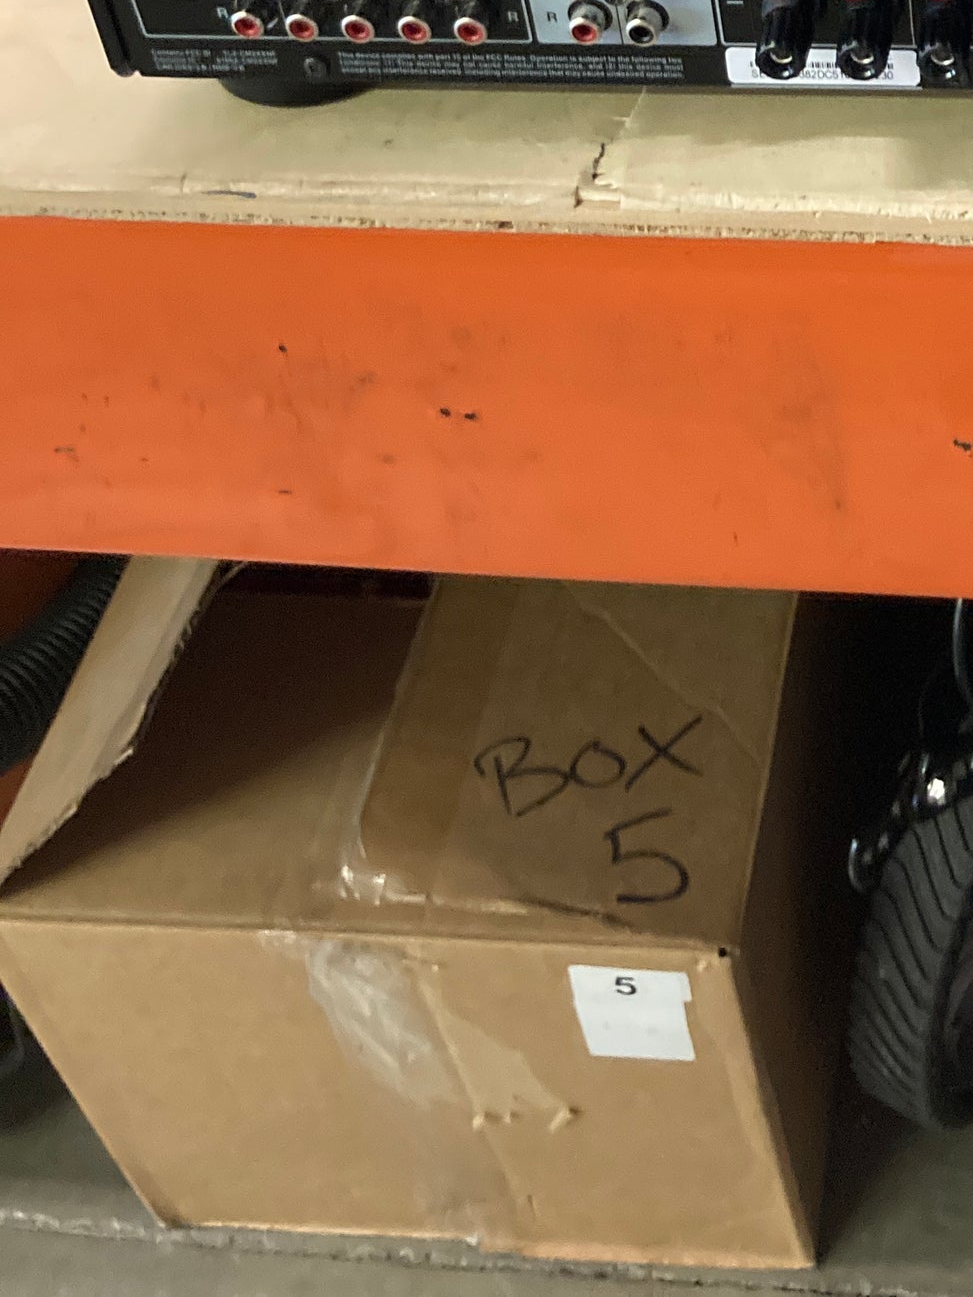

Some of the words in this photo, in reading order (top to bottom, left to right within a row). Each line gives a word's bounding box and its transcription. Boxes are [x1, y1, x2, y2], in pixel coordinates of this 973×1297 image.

[507, 11, 519, 22] R
[546, 11, 558, 22] R
[473, 714, 703, 818] BOX
[604, 807, 690, 904] 5
[614, 976, 637, 996] 5
